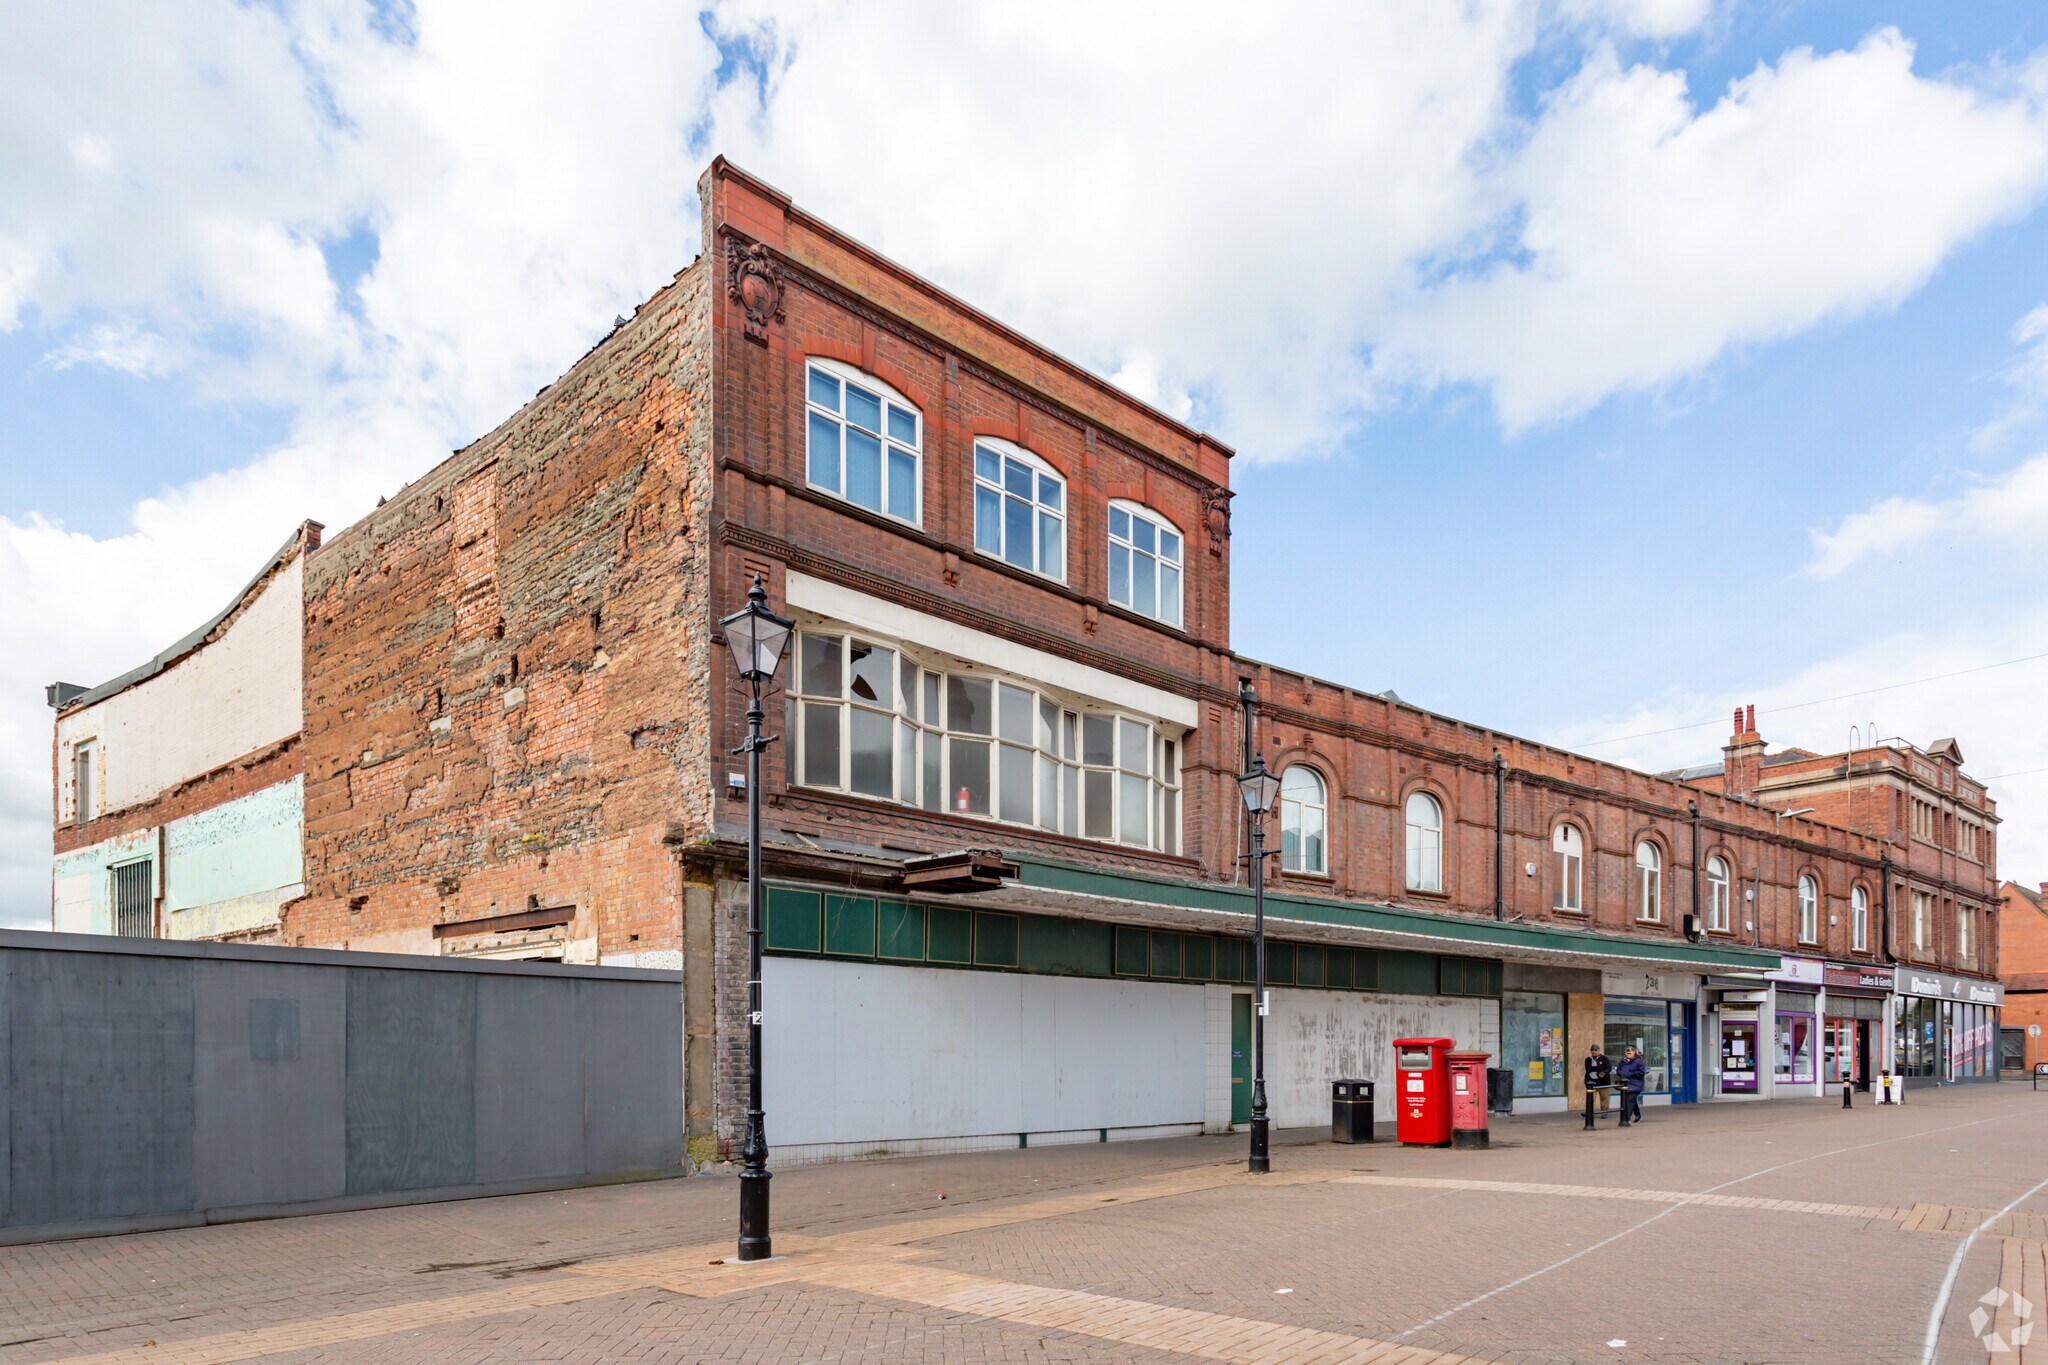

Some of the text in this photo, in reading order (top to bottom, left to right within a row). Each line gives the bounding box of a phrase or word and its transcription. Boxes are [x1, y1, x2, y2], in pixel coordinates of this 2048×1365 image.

[1860, 975, 1874, 986] Ladies
[1874, 976, 1879, 986] &
[1879, 977, 1892, 987] Gents
